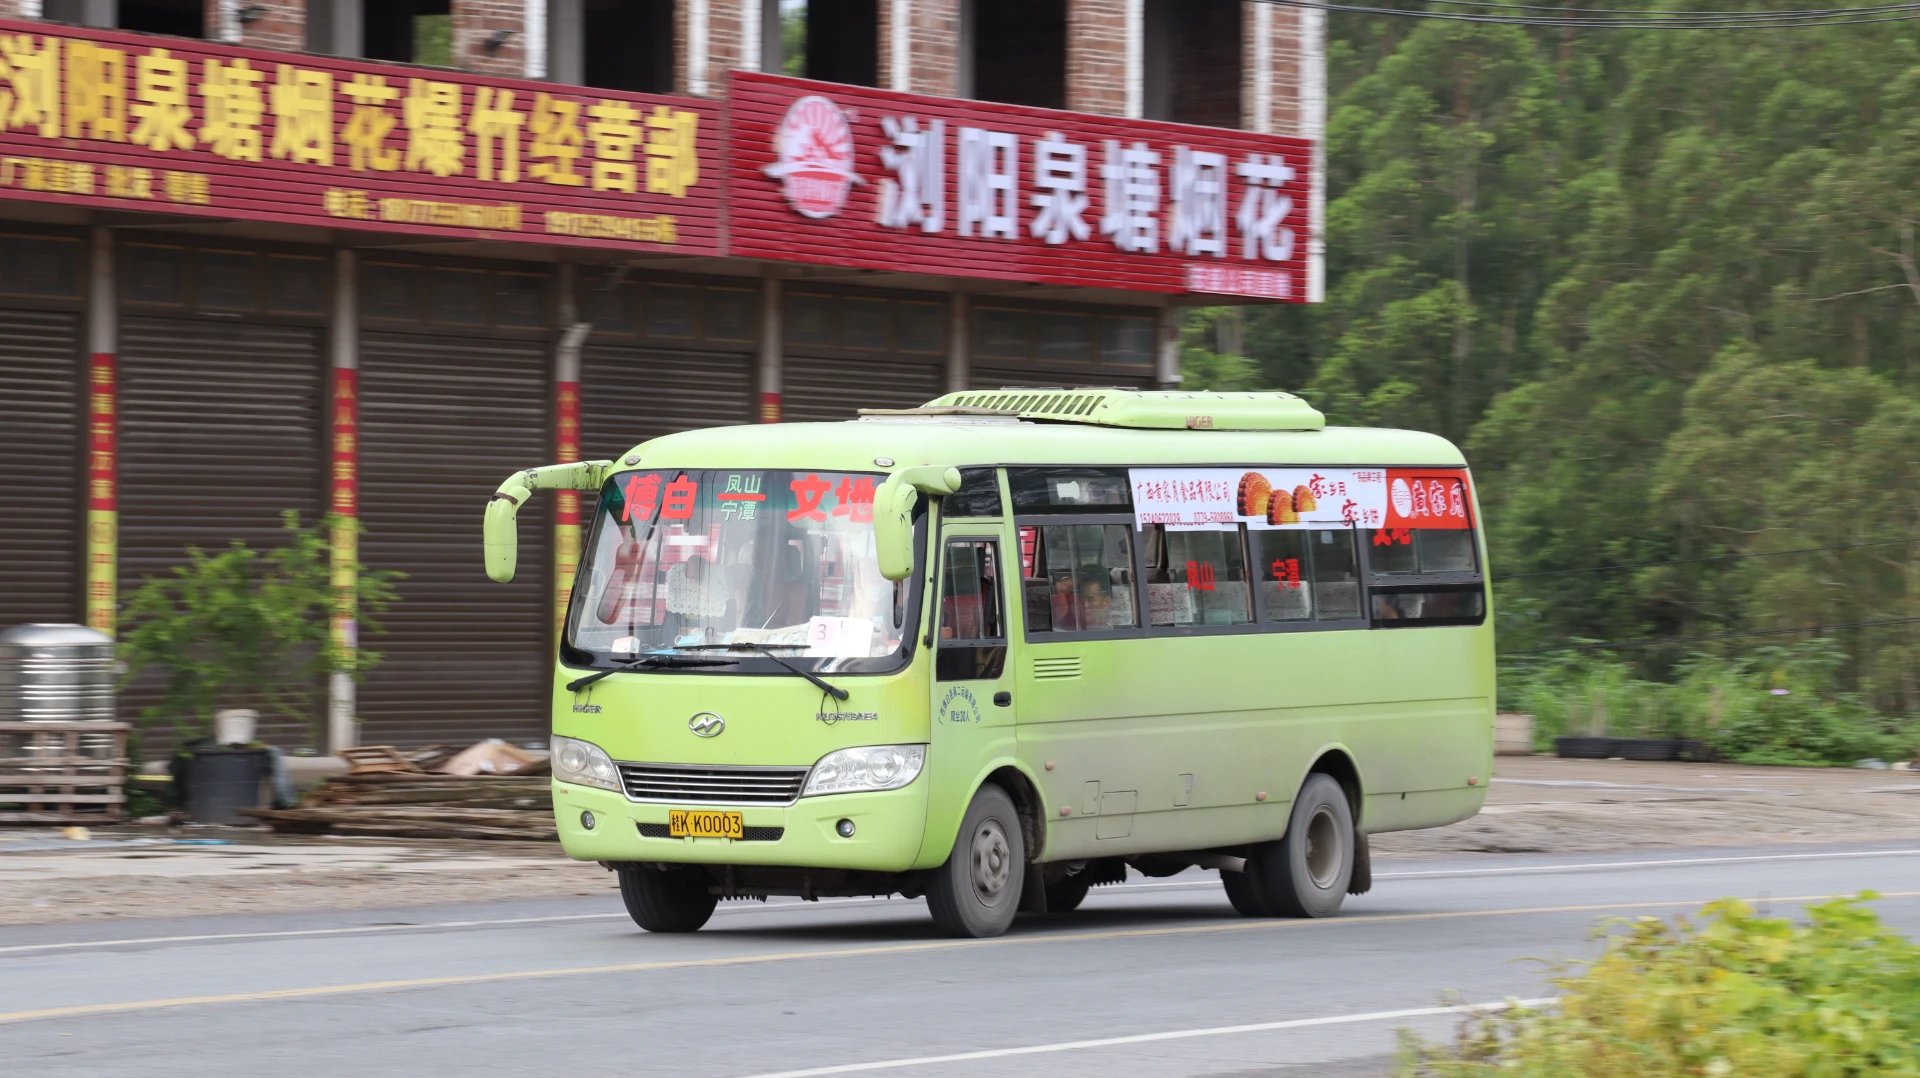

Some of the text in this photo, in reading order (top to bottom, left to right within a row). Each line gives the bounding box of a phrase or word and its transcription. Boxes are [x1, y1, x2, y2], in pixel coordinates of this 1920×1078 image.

[0, 33, 697, 198] 浏阳泉塘烟花爆竹经营部
[876, 114, 1296, 262] 浏阳泉塘烟花
[621, 474, 877, 524] 博白 文地
[724, 474, 762, 495] 凤山
[720, 500, 758, 522] 宁潭
[1186, 558, 1301, 592] 凤山 宁潭
